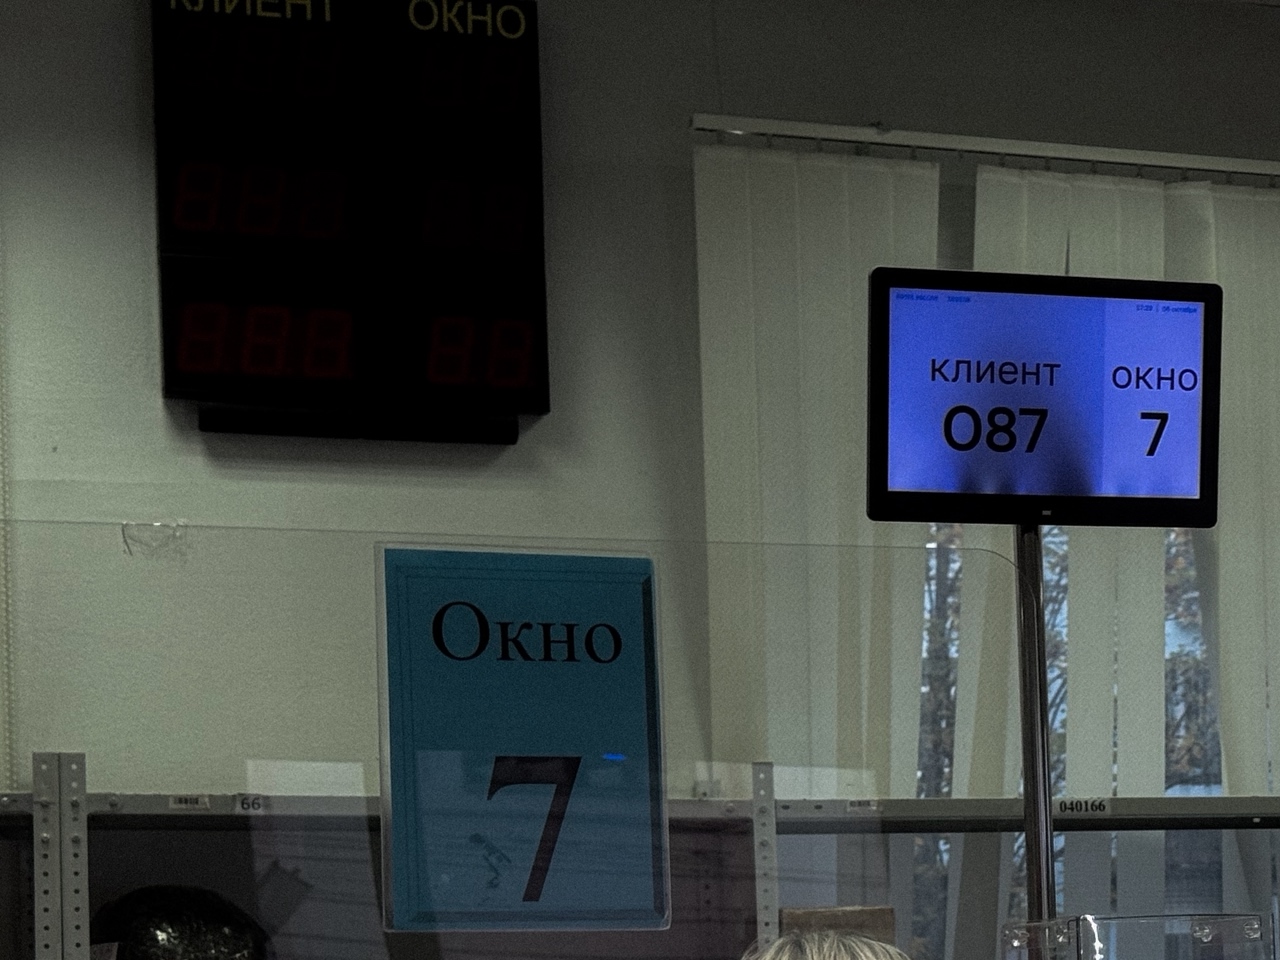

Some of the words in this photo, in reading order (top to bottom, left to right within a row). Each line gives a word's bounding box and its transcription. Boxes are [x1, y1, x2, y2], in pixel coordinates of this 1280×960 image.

[408, 0, 526, 39] ОКНО
[1140, 412, 1169, 457] 7
[432, 601, 623, 664] Окно
[241, 797, 261, 810] 66
[1060, 800, 1106, 813] 040166
[486, 755, 582, 902] 7
